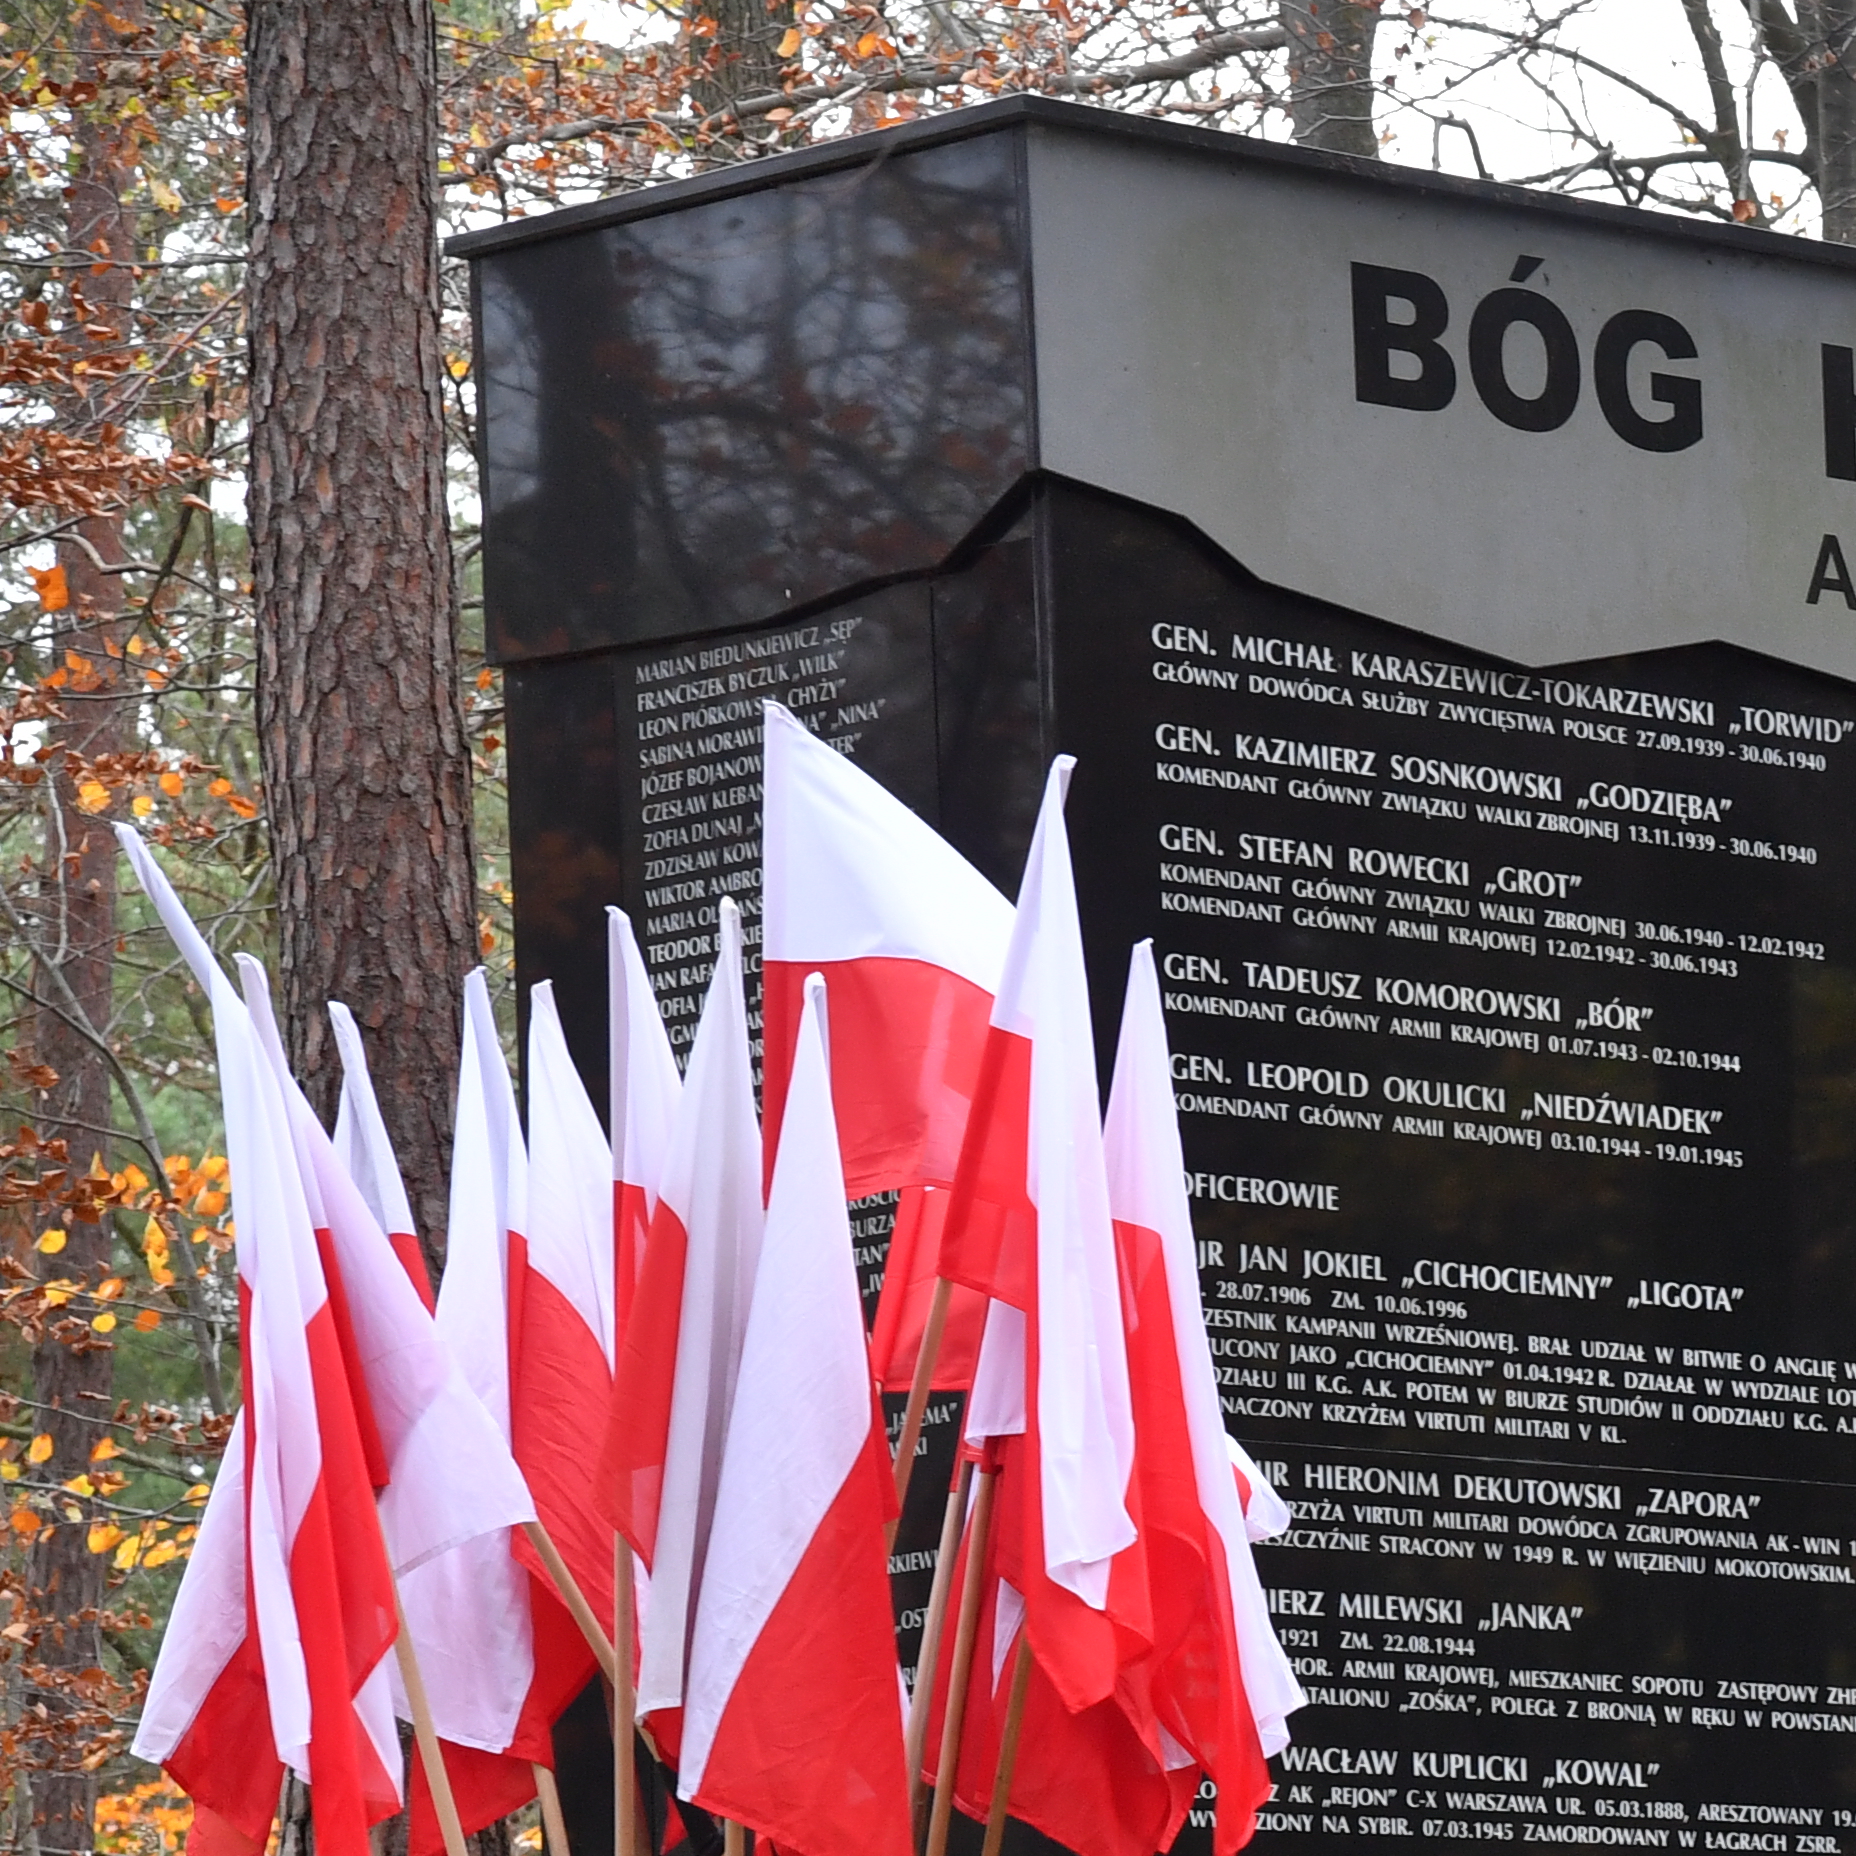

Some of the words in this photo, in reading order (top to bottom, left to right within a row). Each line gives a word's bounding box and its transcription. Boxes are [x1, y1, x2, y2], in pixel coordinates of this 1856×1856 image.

[1350, 263, 1703, 453] BÓG
[1152, 622, 1216, 656] GEN.
[1232, 634, 1336, 673] MICHAŁ
[1352, 651, 1713, 726] KARASZEWICZ-TOKARZEWSKI
[1729, 706, 1854, 743] „TORWID”
[1153, 661, 1238, 690] GŁÓWNY
[1249, 675, 1353, 707] DOWÓDCA
[1362, 690, 1429, 716] SŁUŻBY
[1439, 701, 1555, 735] ZWYCIĘSTWA
[1564, 719, 1627, 745] POLSCE
[1637, 730, 1724, 757] 27.09.1939
[1740, 744, 1826, 772] 30.06.1940
[1156, 723, 1220, 756] GEN.
[1236, 734, 1376, 777] KAZIMIERZ
[1391, 754, 1561, 802] SOSNKOWSKI
[1577, 782, 1732, 823] „GODZIĘBA”
[1160, 824, 1223, 856] GEN.
[1240, 833, 1332, 870] STEFAN
[1349, 848, 1468, 886] ROWECKI
[1485, 866, 1581, 899] „GROT”
[1164, 953, 1228, 984] GEN.
[1243, 961, 1361, 999] TADEUSZ
[1377, 977, 1560, 1022] KOMOROWSKI
[1576, 998, 1653, 1032] „BÓR”
[1169, 1053, 1232, 1085] GEN.
[1248, 1062, 1368, 1098] LEOPOLD
[1384, 1076, 1505, 1113] OKULICKI
[1521, 1092, 1722, 1135] „NIEDŹWIADEK”
[1240, 1245, 1286, 1273] JAN
[1304, 1250, 1387, 1282] JOKIEL
[1402, 1260, 1612, 1300] „CICHOCIEMNY”
[1628, 1280, 1743, 1312] „LIGOTA”
[1305, 1464, 1439, 1497] HIERONIM
[1455, 1474, 1620, 1510] DEKUTOWSKI
[1636, 1488, 1760, 1519] „ZAPORA”
[1340, 1593, 1462, 1624] MILEWSKI
[1478, 1602, 1583, 1631] „JANKA”
[1280, 1744, 1397, 1775] WACŁAW
[1414, 1752, 1527, 1782] KUPLICKI
[1543, 1759, 1659, 1789] „KOWAL”
